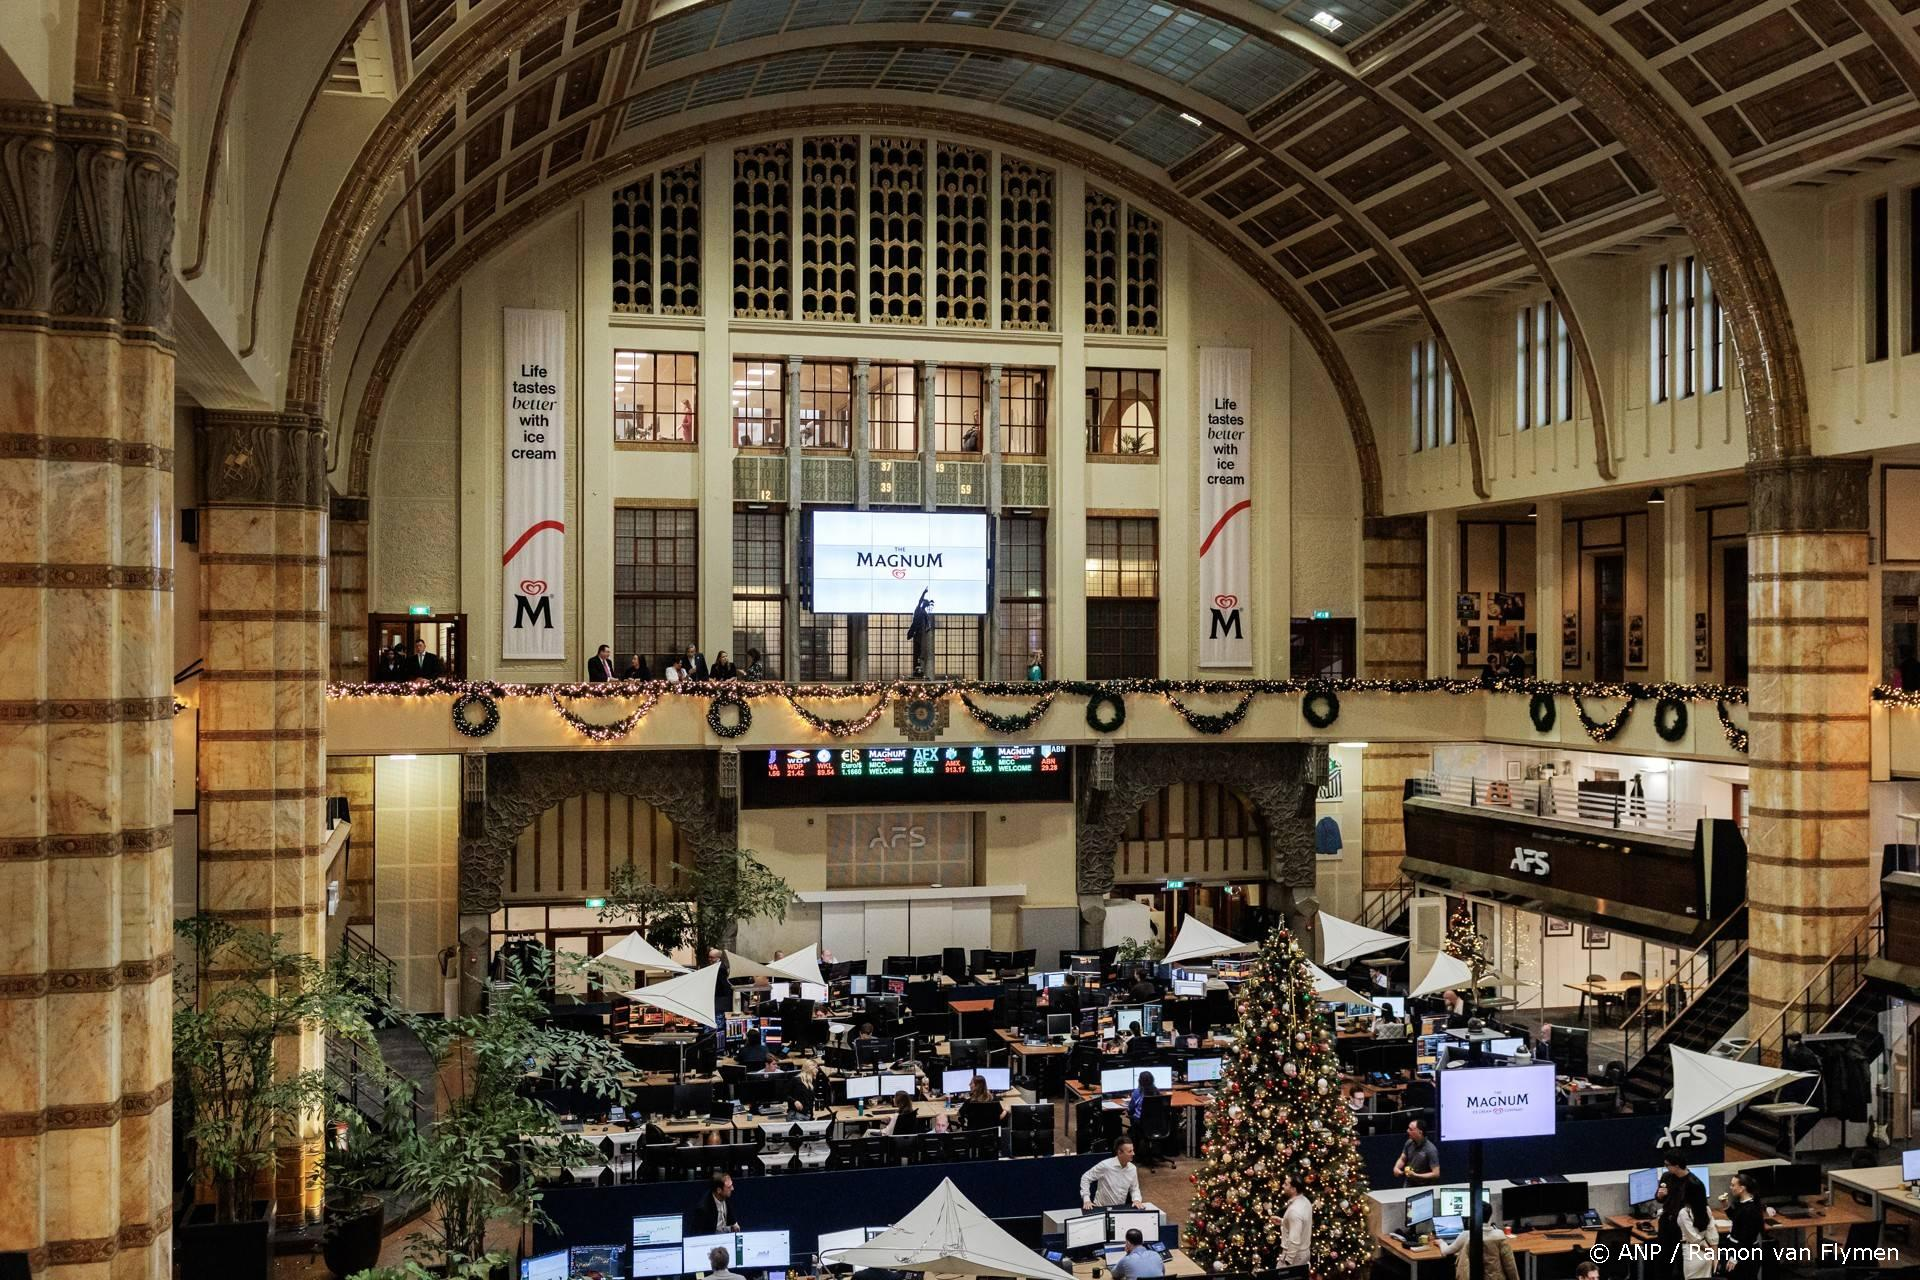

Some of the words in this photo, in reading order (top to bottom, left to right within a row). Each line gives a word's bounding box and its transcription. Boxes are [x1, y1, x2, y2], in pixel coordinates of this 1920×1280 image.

[521, 364, 548, 378] Life
[513, 381, 556, 395] tastes
[512, 396, 558, 411] better
[1215, 398, 1237, 410] Life
[519, 414, 549, 427] with
[1208, 413, 1244, 425] tastes
[523, 430, 545, 443] ice
[1207, 427, 1245, 440] better
[511, 449, 557, 460] cream
[1213, 443, 1238, 455] with
[880, 462, 892, 472] 37
[1217, 458, 1235, 470] ice
[1207, 475, 1245, 485] cream
[880, 482, 892, 493] 39
[960, 484, 971, 495] 59
[761, 489, 771, 500] 12
[857, 552, 943, 568] MAGNUM
[513, 594, 554, 629] M
[1209, 608, 1244, 639] M
[868, 749, 906, 758] MAGNUM
[913, 747, 939, 761] AEX
[998, 747, 1035, 756] MAGNUM
[868, 767, 904, 775] WELCOME
[869, 826, 927, 849] AFS
[1510, 846, 1550, 876] AFS
[1466, 1093, 1529, 1108] MAGNUM
[1656, 1124, 1708, 1149] AFS
